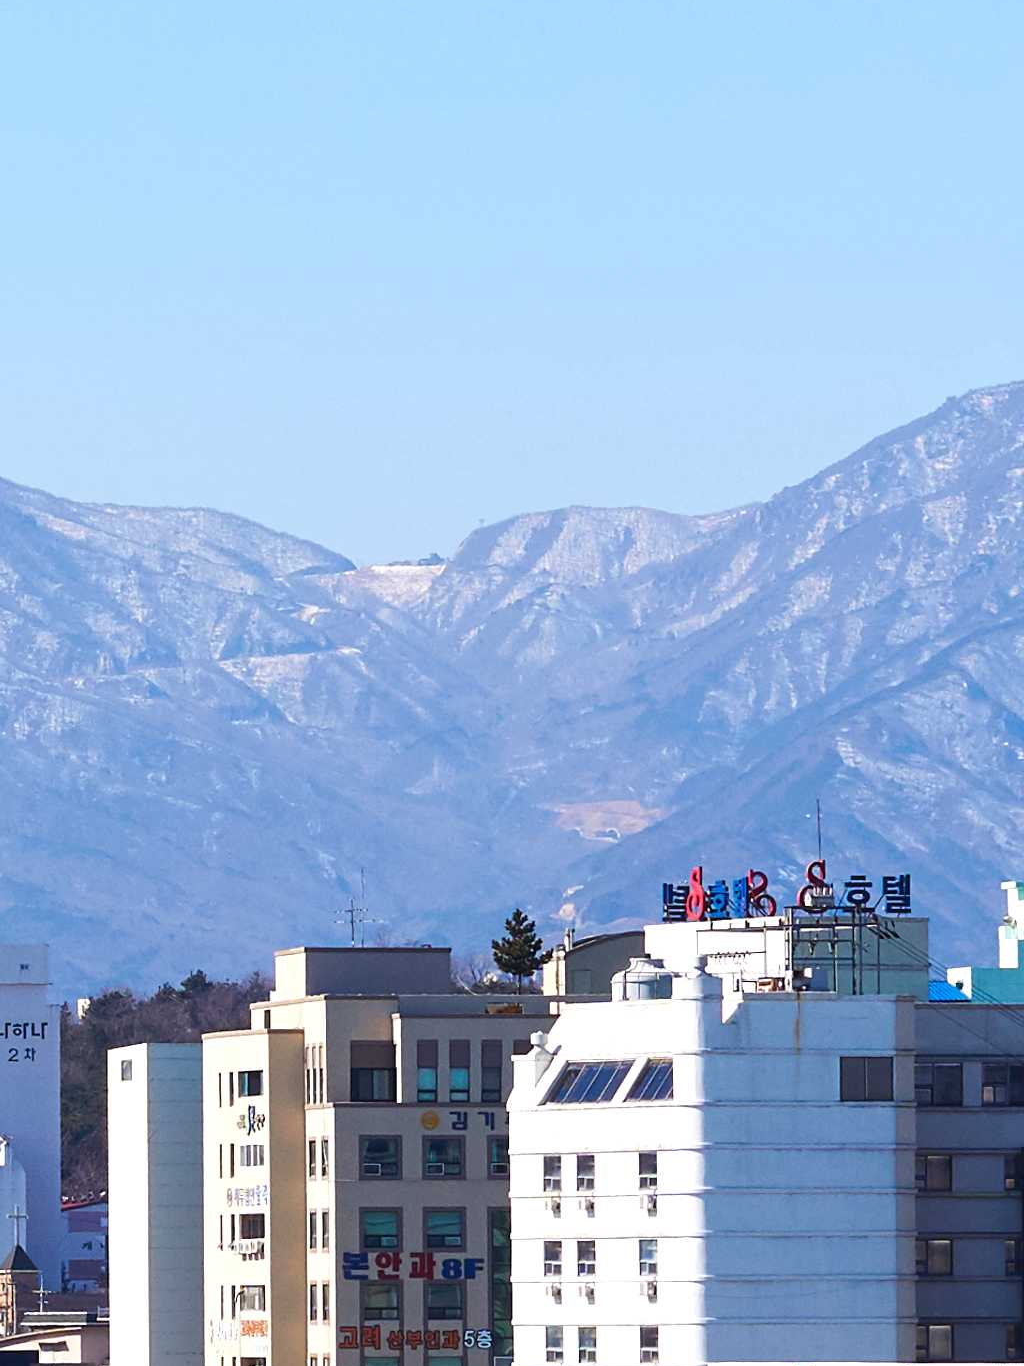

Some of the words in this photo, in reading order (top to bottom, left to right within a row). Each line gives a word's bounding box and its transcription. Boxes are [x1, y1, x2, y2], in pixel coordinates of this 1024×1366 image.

[842, 874, 912, 914] 호텔
[8, 1047, 36, 1062] 2차
[450, 1111, 509, 1131] 김기
[342, 1251, 436, 1281] 본안과
[441, 1258, 485, 1280] 8F
[338, 1324, 381, 1350] 고려
[387, 1329, 461, 1351] 산부인과
[464, 1329, 493, 1350] 5층
